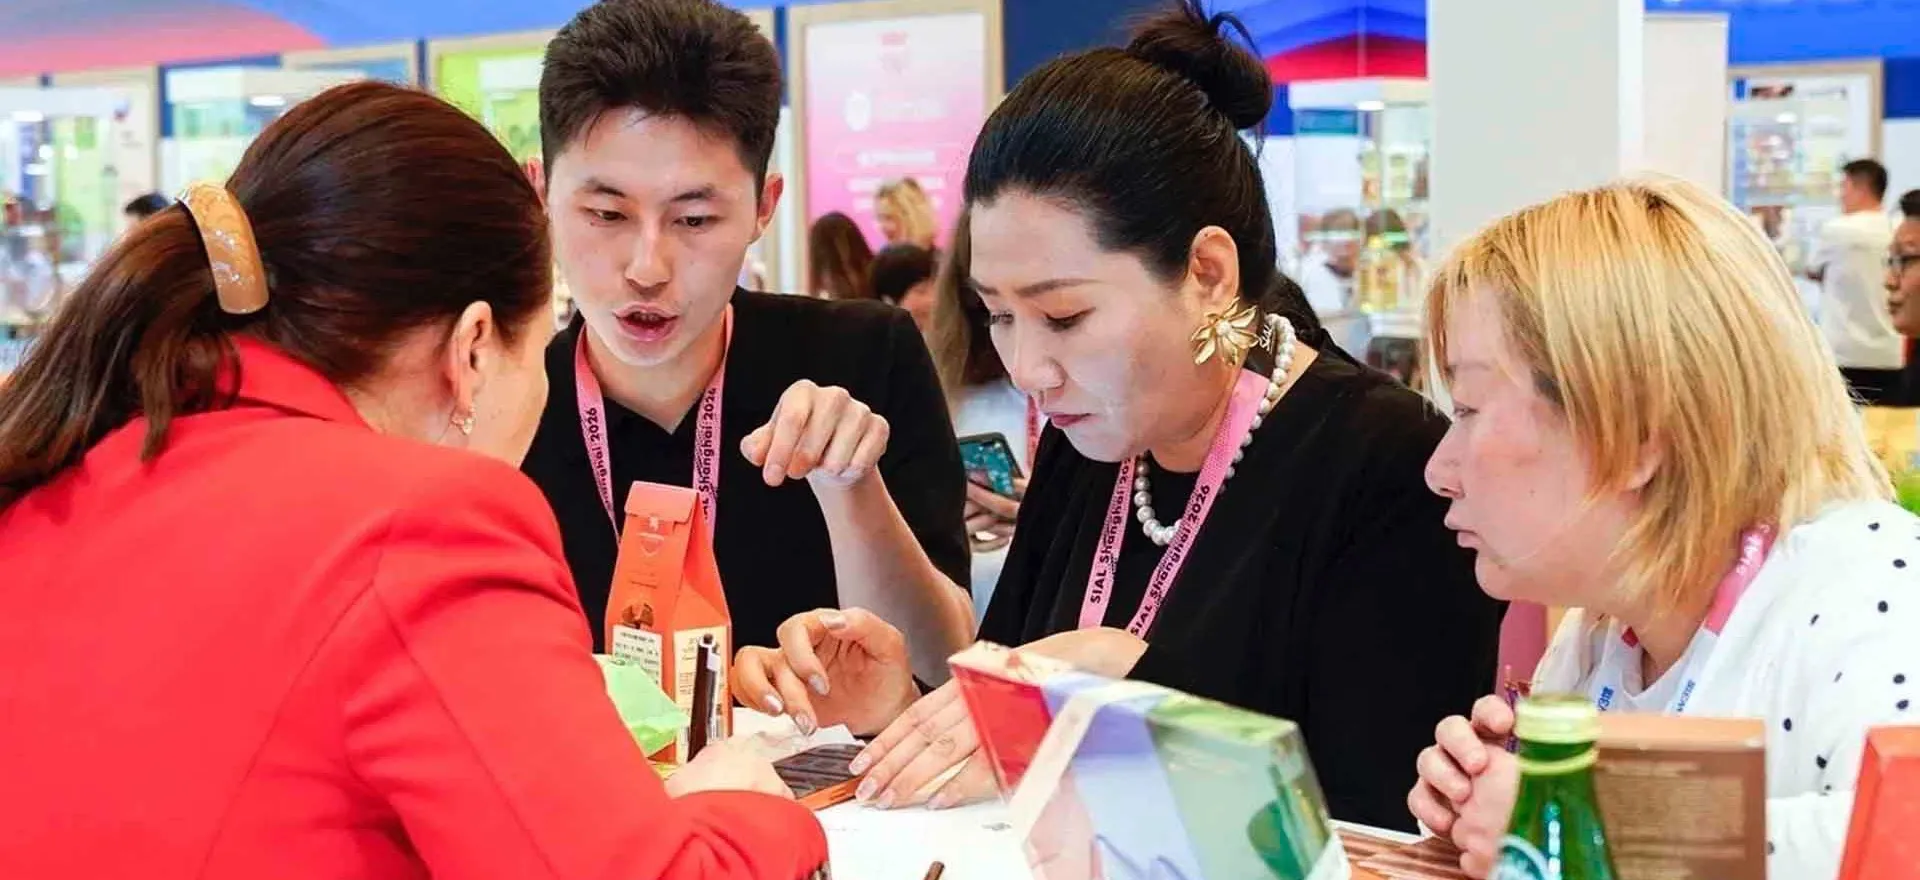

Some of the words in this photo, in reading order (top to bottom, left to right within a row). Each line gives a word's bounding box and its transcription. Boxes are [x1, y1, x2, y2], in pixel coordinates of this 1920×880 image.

[586, 407, 599, 443] 2026
[699, 423, 715, 493] Shanghai
[1090, 569, 1107, 604] SIAL
[1099, 489, 1125, 564] Shanghai
[1130, 604, 1153, 636] SIAL
[1150, 525, 1192, 600] Shanghai
[1188, 483, 1211, 524] 2026
